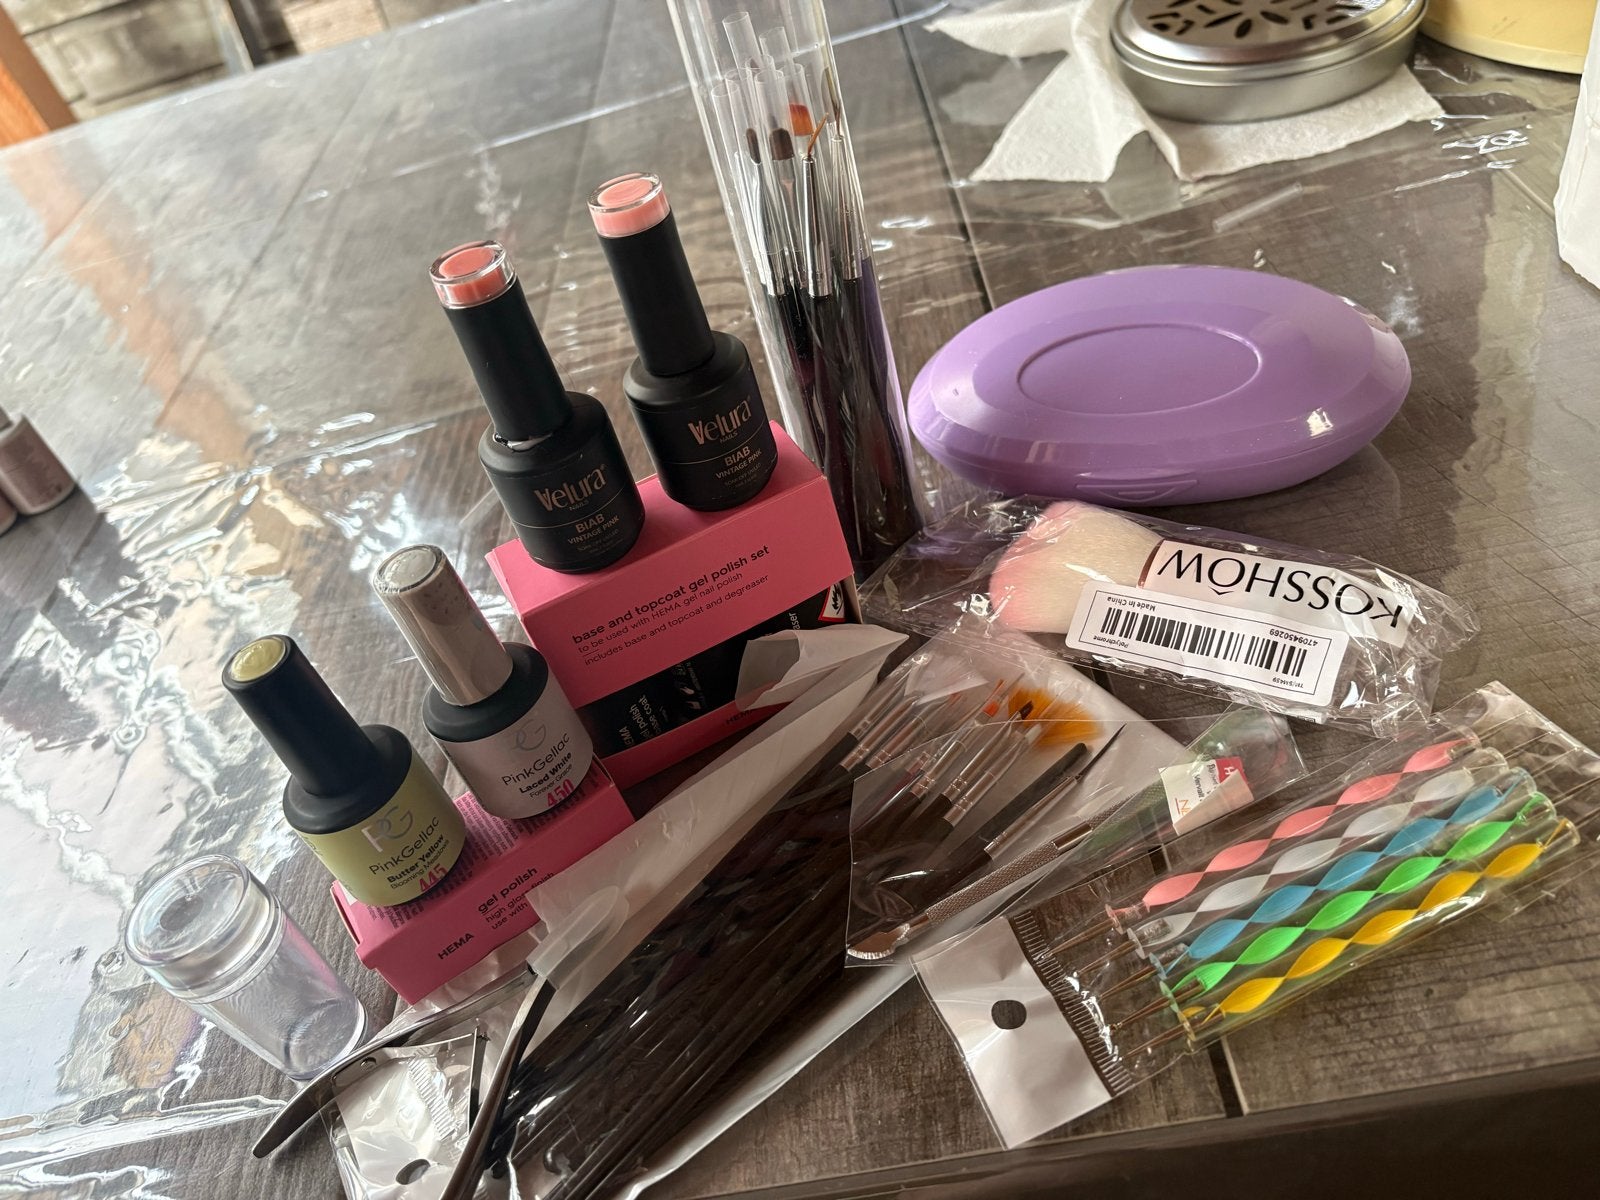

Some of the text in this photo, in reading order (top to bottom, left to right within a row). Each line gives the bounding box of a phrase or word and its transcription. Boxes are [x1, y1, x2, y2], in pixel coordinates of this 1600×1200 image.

[687, 400, 752, 445] Velura
[719, 431, 738, 443] NAILS
[715, 448, 762, 479] VINTAGE PINK
[724, 446, 751, 466] BIAB
[534, 468, 606, 512] Velura
[567, 529, 601, 544] VINTAGE
[602, 515, 619, 530] PINK
[575, 513, 605, 533] BIAB
[572, 545, 770, 644] base and topcoat gel polish set
[1106, 596, 1127, 606] China
[1136, 601, 1156, 612] Made
[578, 572, 743, 654] to be used with HEMA gel nail polish
[584, 575, 769, 666] includes base and topcoat and degreaser
[1093, 635, 1129, 648] Polychrome
[726, 709, 752, 726] HEM
[619, 726, 634, 746] EMA
[501, 733, 570, 786] PinkGellac
[519, 752, 572, 794] Laced White
[529, 763, 573, 798] Forever Grace
[368, 816, 440, 875] PinkGellac
[386, 862, 420, 883] Butter
[418, 834, 444, 862] Yellow
[390, 868, 425, 889] Blooming
[478, 893, 499, 914] gel
[500, 867, 538, 898] polish
[485, 906, 506, 923] high
[491, 902, 528, 930] use with
[437, 932, 475, 960] HEMA
